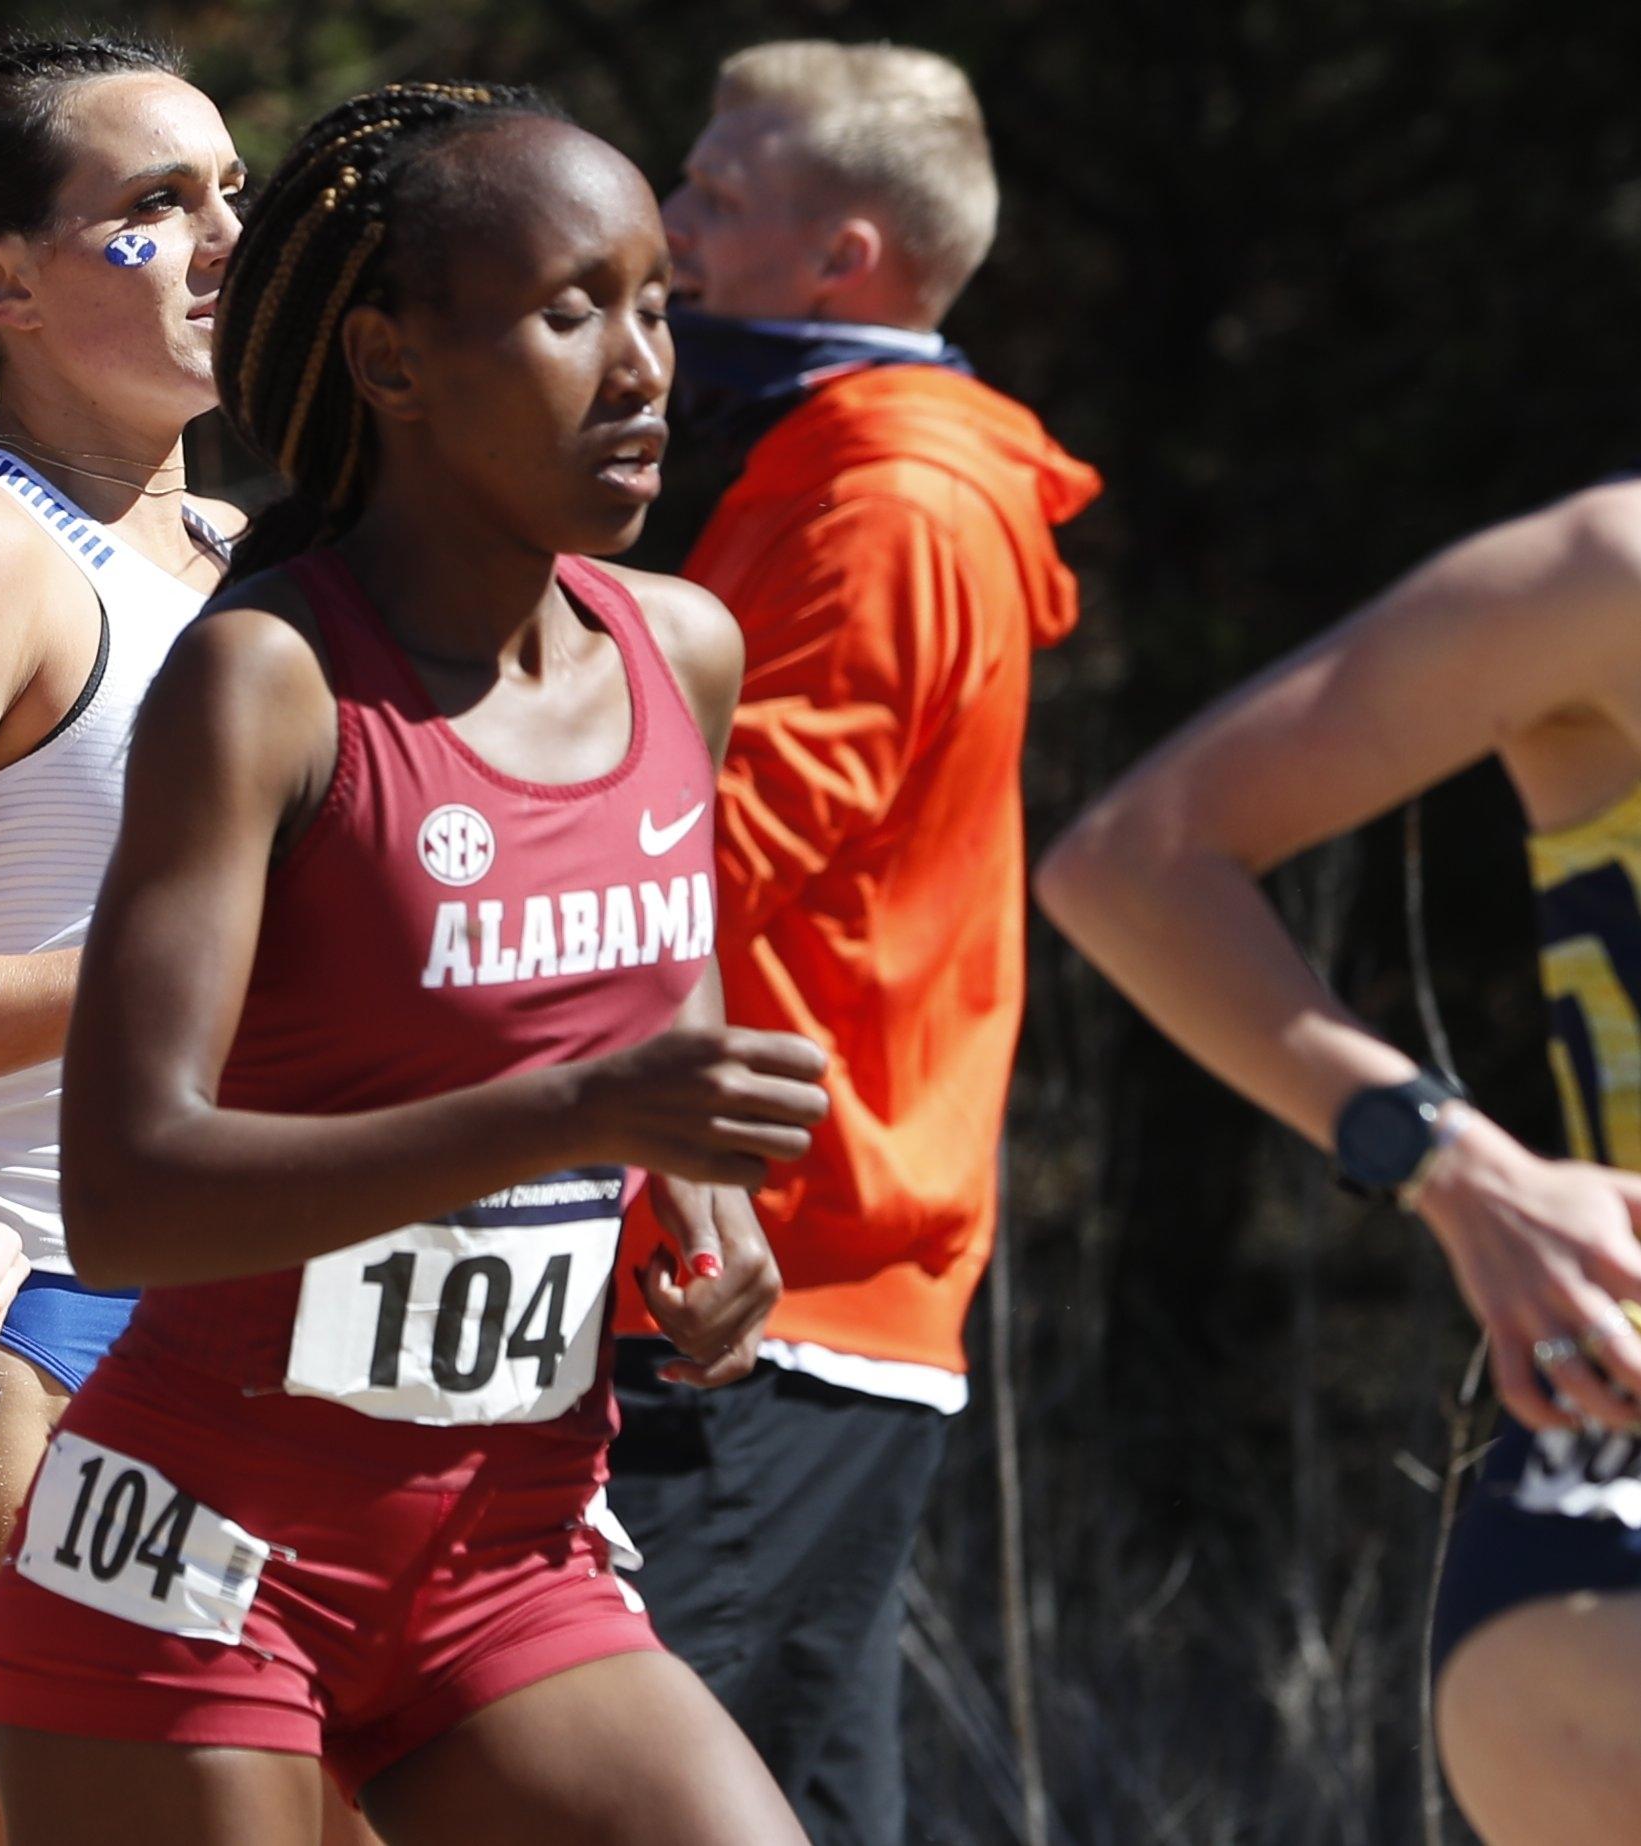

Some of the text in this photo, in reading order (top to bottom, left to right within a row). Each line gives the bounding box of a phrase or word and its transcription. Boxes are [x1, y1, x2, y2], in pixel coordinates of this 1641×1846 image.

[421, 809, 490, 881] SEC
[421, 872, 714, 989] ALABAMA
[510, 1179, 622, 1208] CHAMPIONSHIPS
[362, 1251, 573, 1392] 104
[54, 1457, 198, 1602] 104
